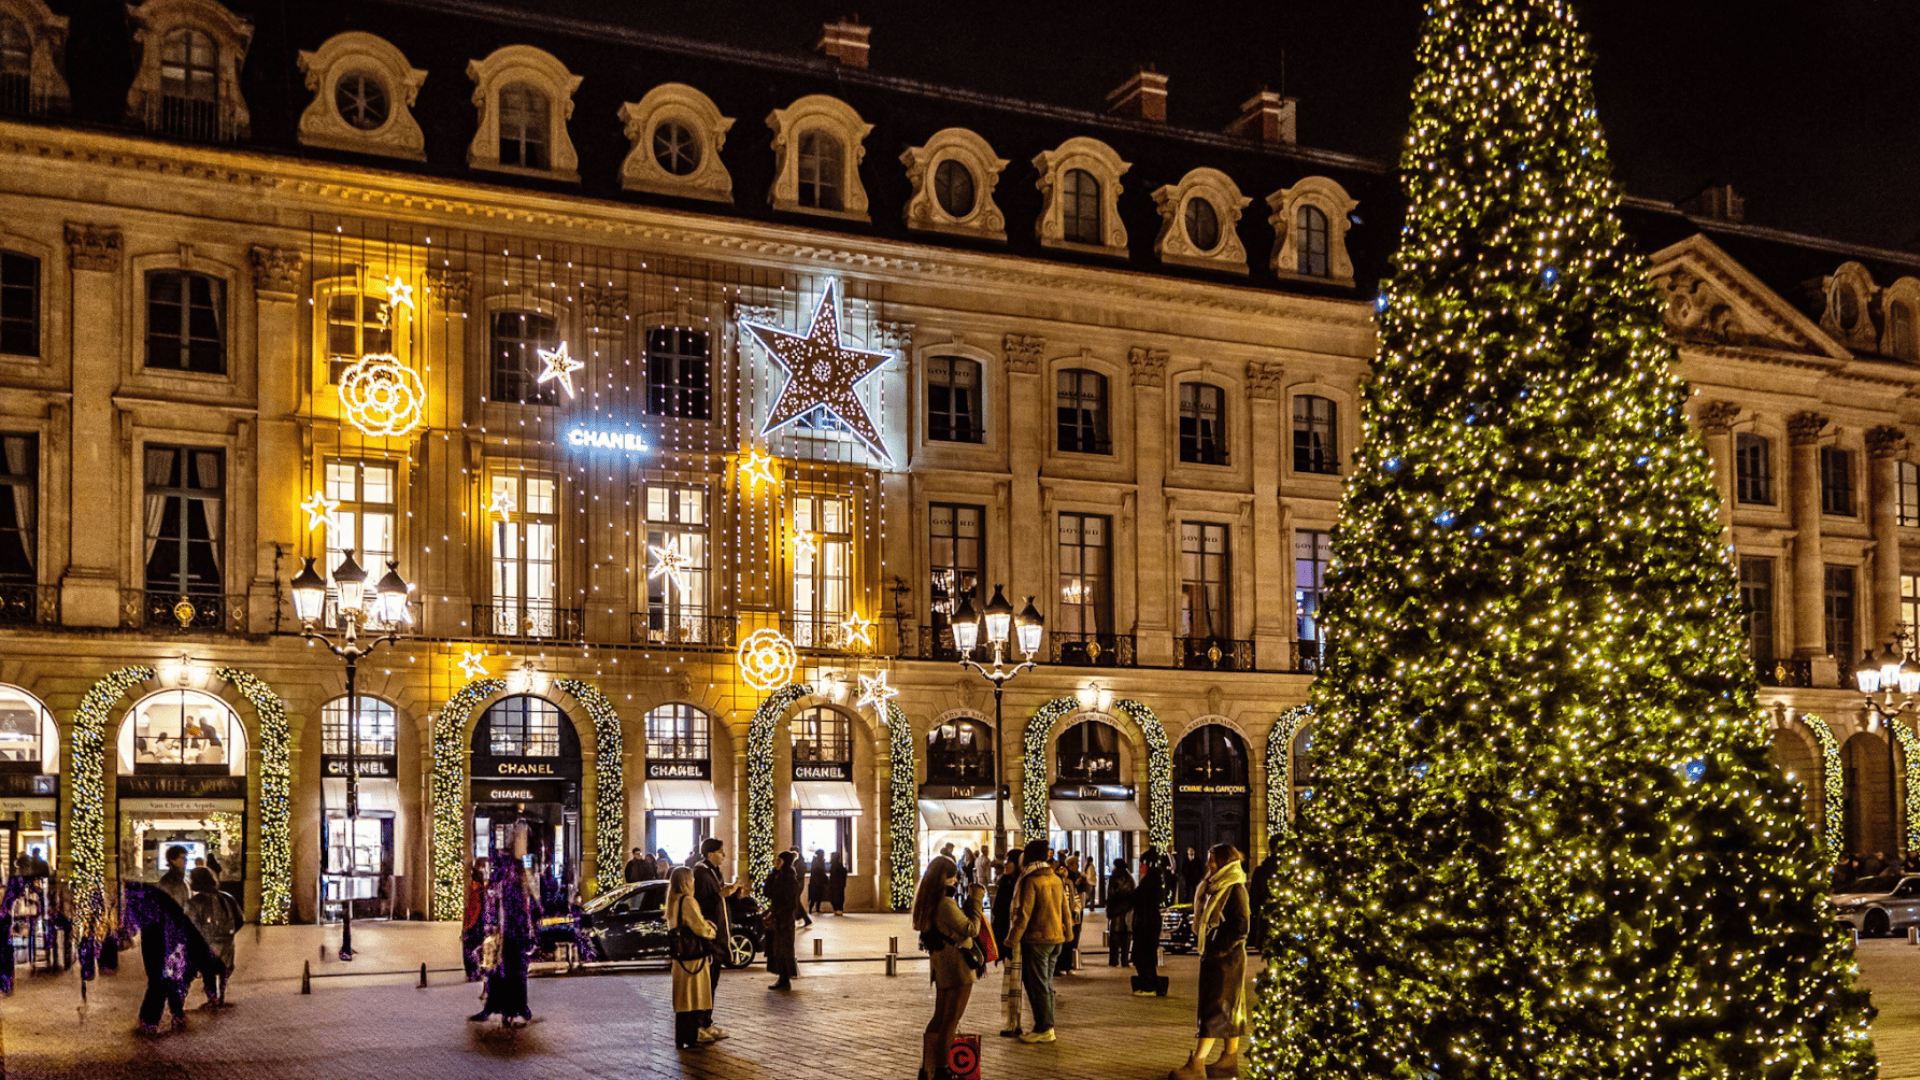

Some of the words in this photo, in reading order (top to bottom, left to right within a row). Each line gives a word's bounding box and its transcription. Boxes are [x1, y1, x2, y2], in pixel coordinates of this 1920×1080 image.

[568, 429, 649, 452] CHANEL
[932, 519, 975, 527] GOYRD
[1059, 527, 1099, 536] GOYRD
[1181, 535, 1218, 543] GOYRD
[498, 763, 554, 774] CHANEL
[650, 765, 703, 777] CHANEL
[795, 766, 845, 778] CHANEL
[490, 790, 534, 799] CHANEL
[1179, 785, 1202, 793] COMME
[947, 812, 991, 826] PIAGET
[1077, 812, 1119, 826] PIAGET
